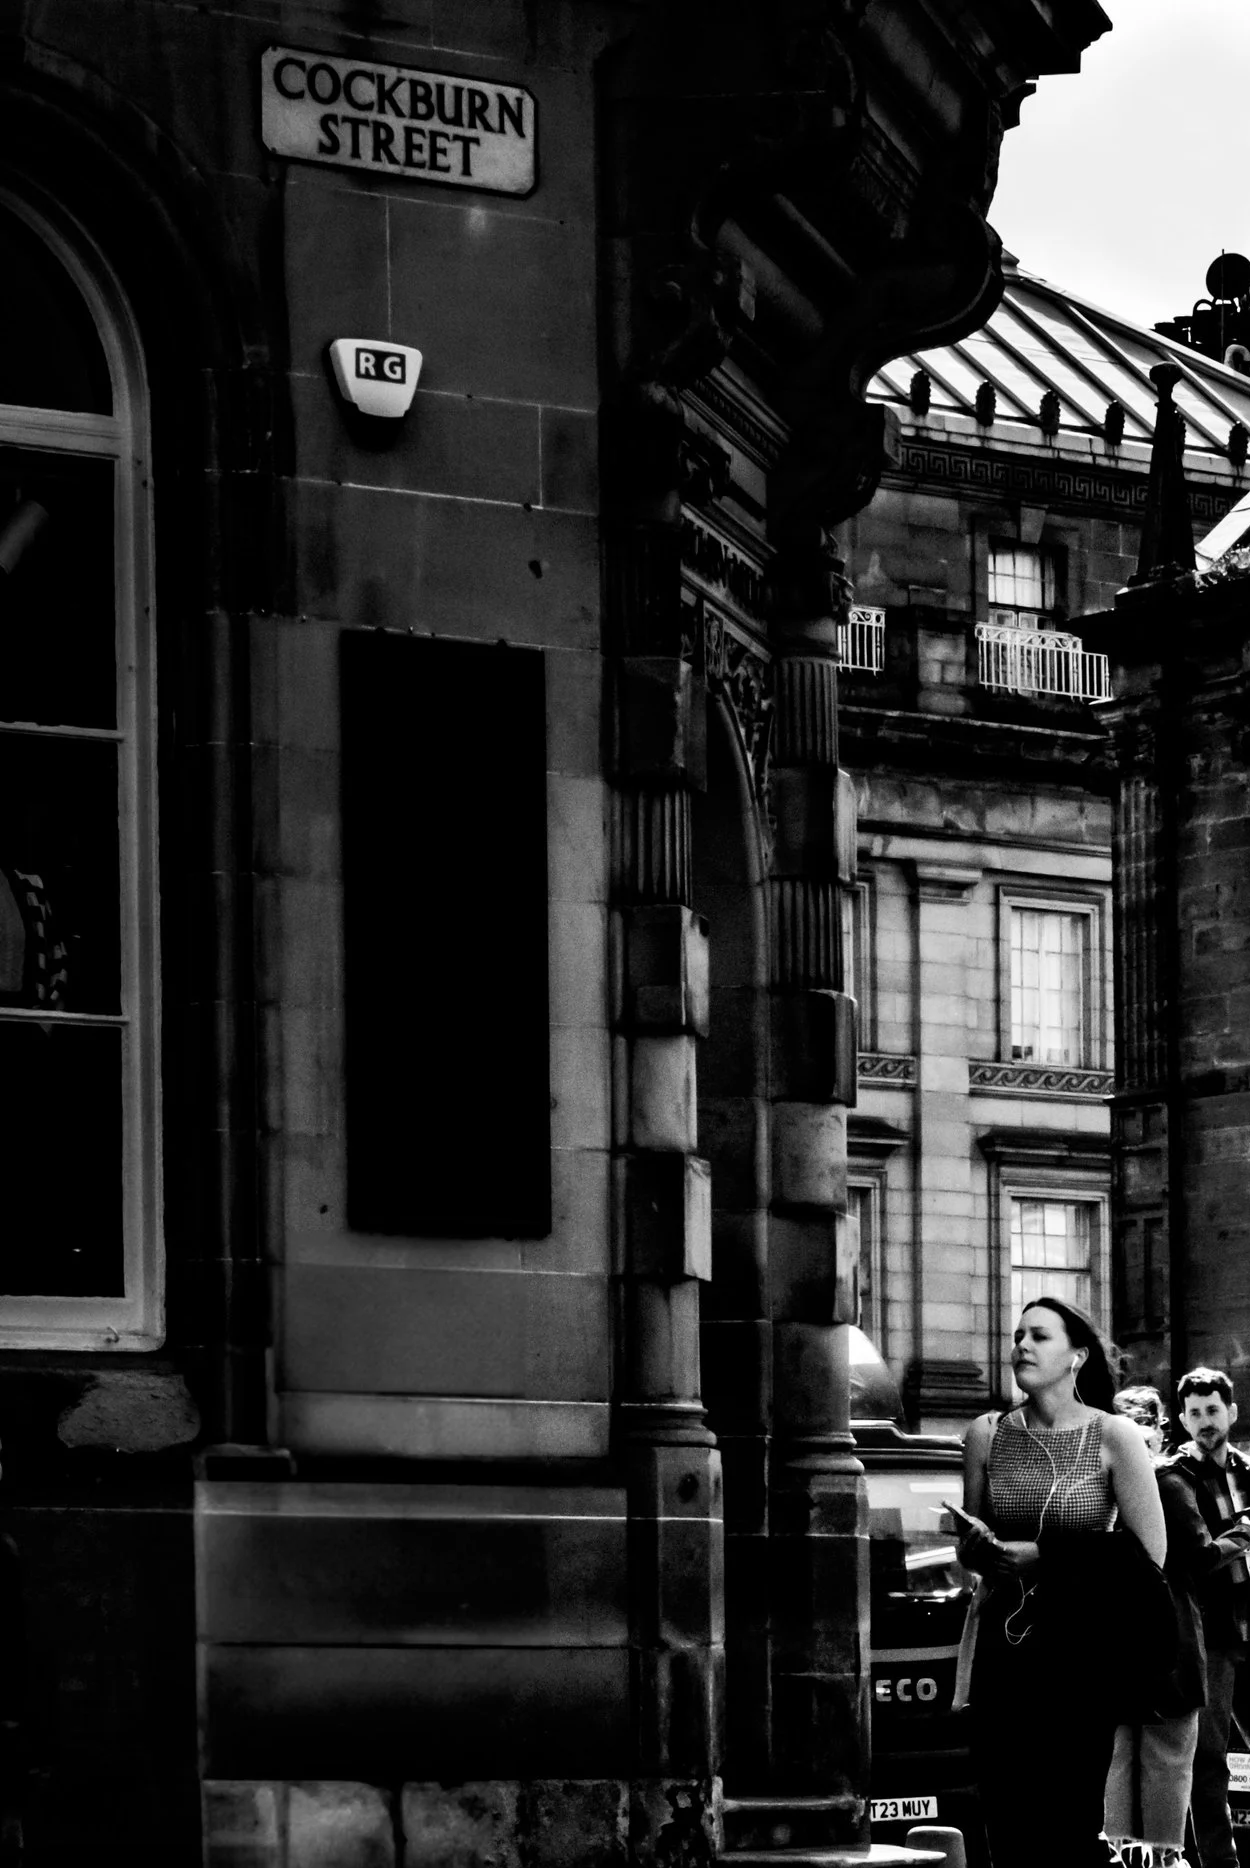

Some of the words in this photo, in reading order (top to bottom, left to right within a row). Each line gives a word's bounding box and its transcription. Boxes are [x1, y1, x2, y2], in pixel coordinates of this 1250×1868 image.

[273, 57, 526, 138] COCKBURN
[318, 113, 481, 177] STREET
[358, 351, 404, 380] RG
[875, 1677, 938, 1702] ECO
[902, 1799, 930, 1817] MUY
